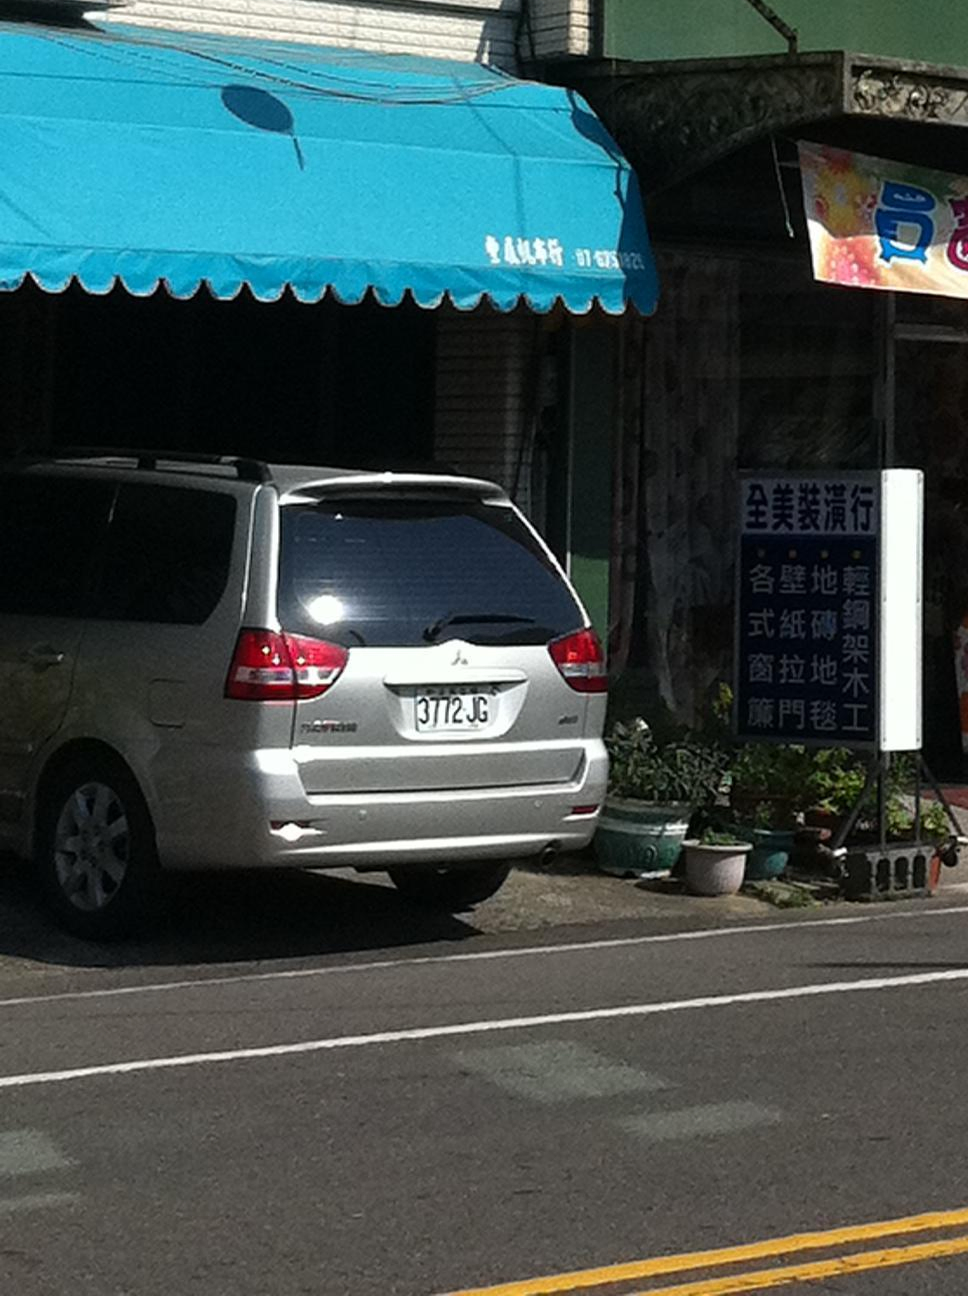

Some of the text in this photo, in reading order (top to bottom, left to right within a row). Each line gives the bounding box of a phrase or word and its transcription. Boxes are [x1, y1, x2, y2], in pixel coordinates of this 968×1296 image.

[745, 483, 874, 532] 全美裝潢行
[748, 564, 776, 729] 各式窗簾
[778, 564, 806, 730] 壁紙拉門
[810, 564, 838, 732] 地磚地毯
[842, 565, 870, 733] 輕鋼架木工
